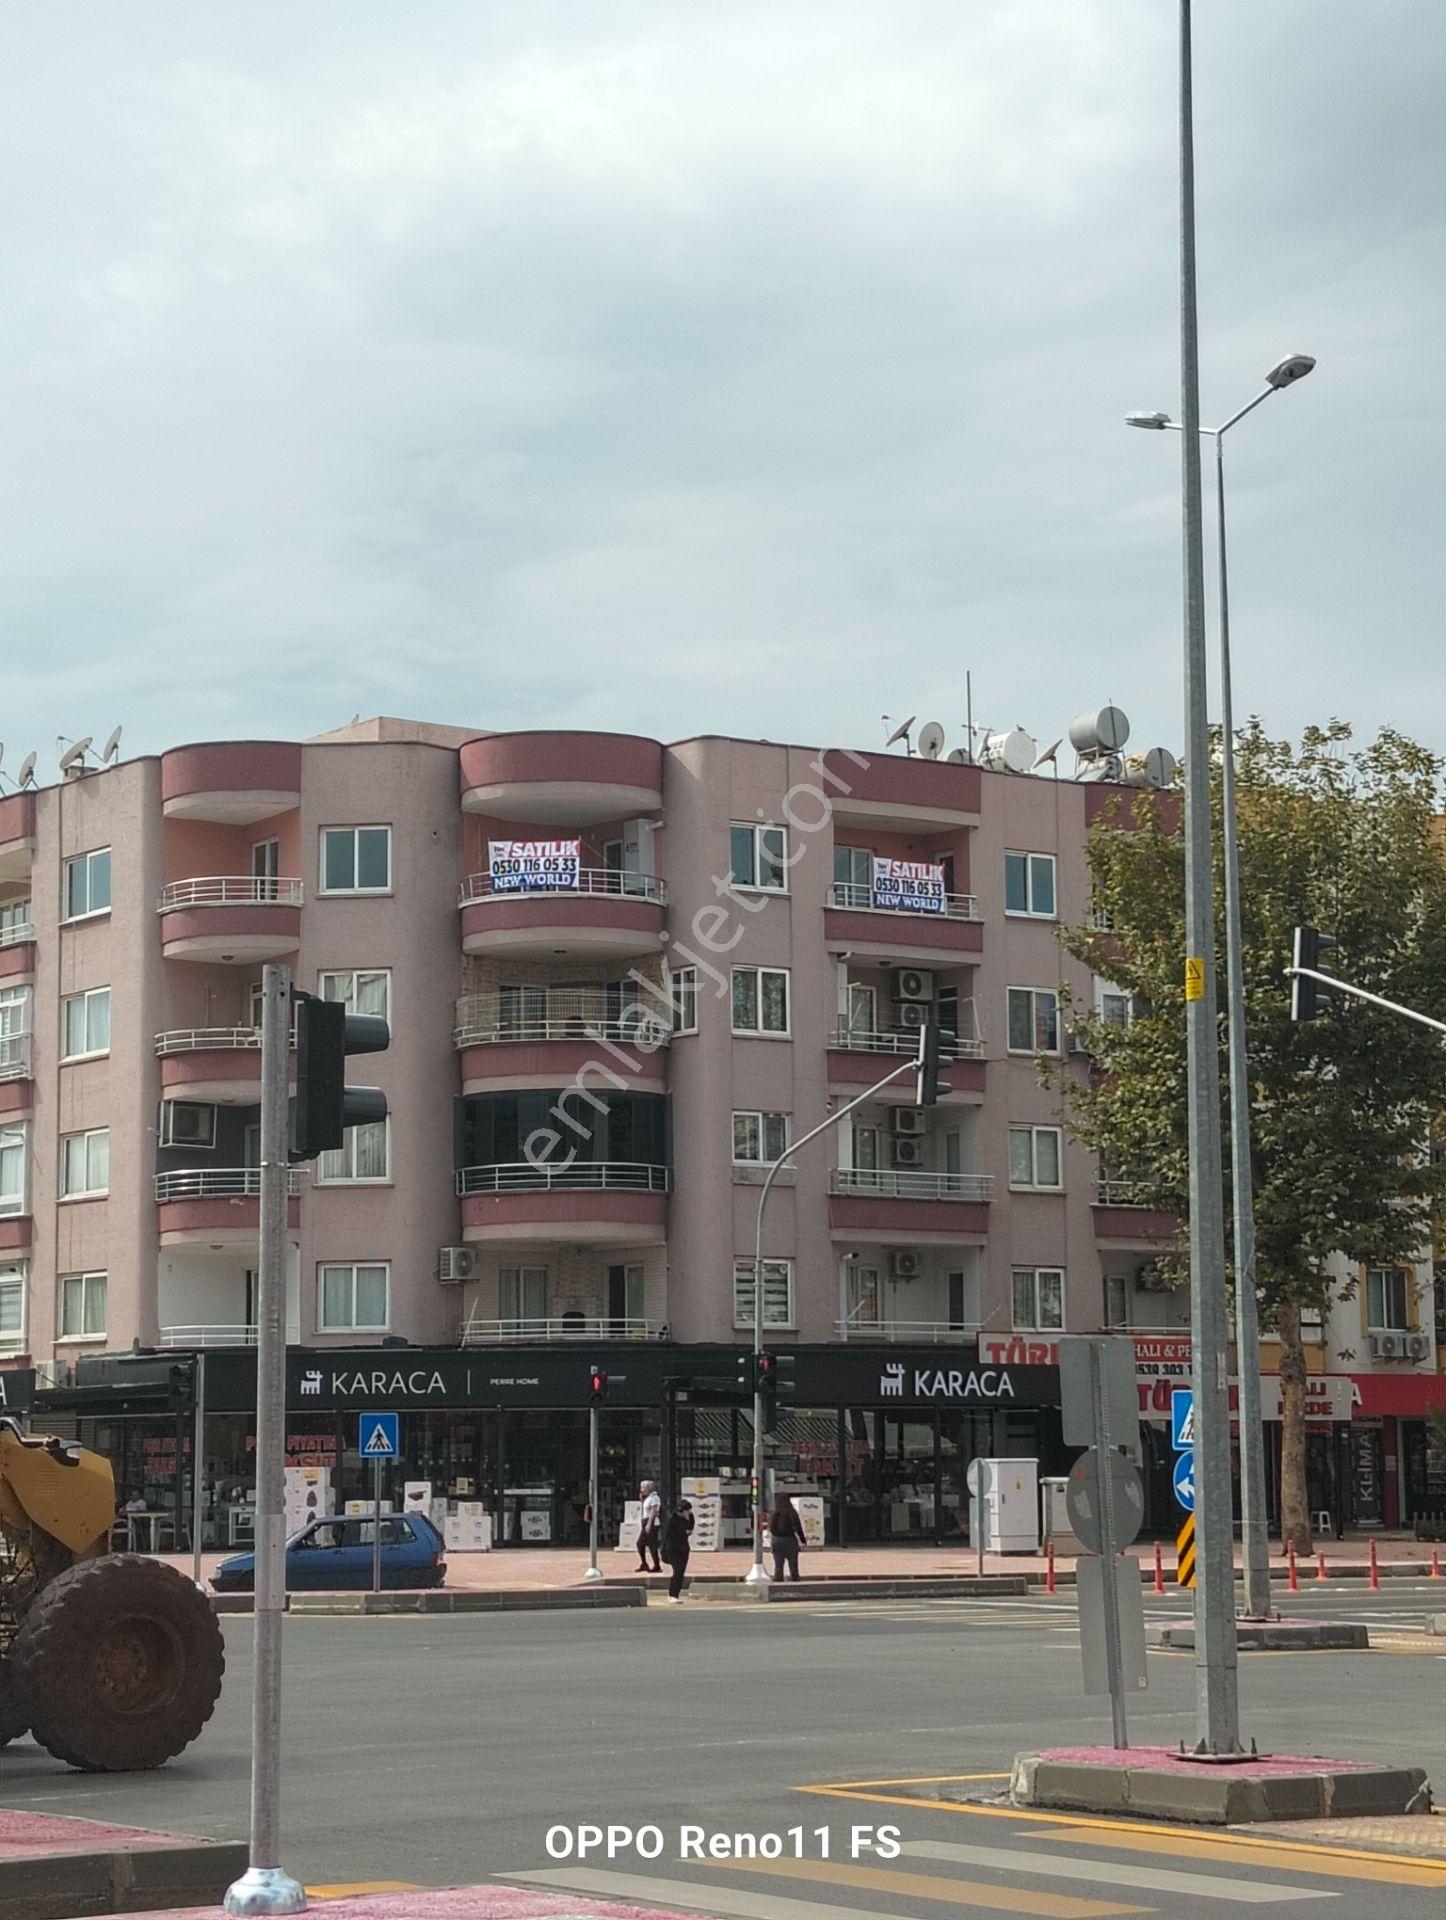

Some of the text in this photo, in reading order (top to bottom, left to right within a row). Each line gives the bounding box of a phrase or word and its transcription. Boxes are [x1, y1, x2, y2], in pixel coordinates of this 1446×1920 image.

[512, 841, 578, 856] SATILIK
[492, 859, 576, 875] 0530 116 05 33
[891, 861, 944, 881] SATILIK
[494, 873, 571, 889] NEW WORLD
[876, 877, 942, 897] 0530 116 05 33
[876, 894, 939, 910] NEW WORLD
[1163, 1343, 1176, 1358] &
[1177, 1344, 1192, 1358] PE
[331, 1371, 447, 1395] KARACA
[515, 1377, 540, 1386] HOME
[914, 1370, 1015, 1398] KARACA
